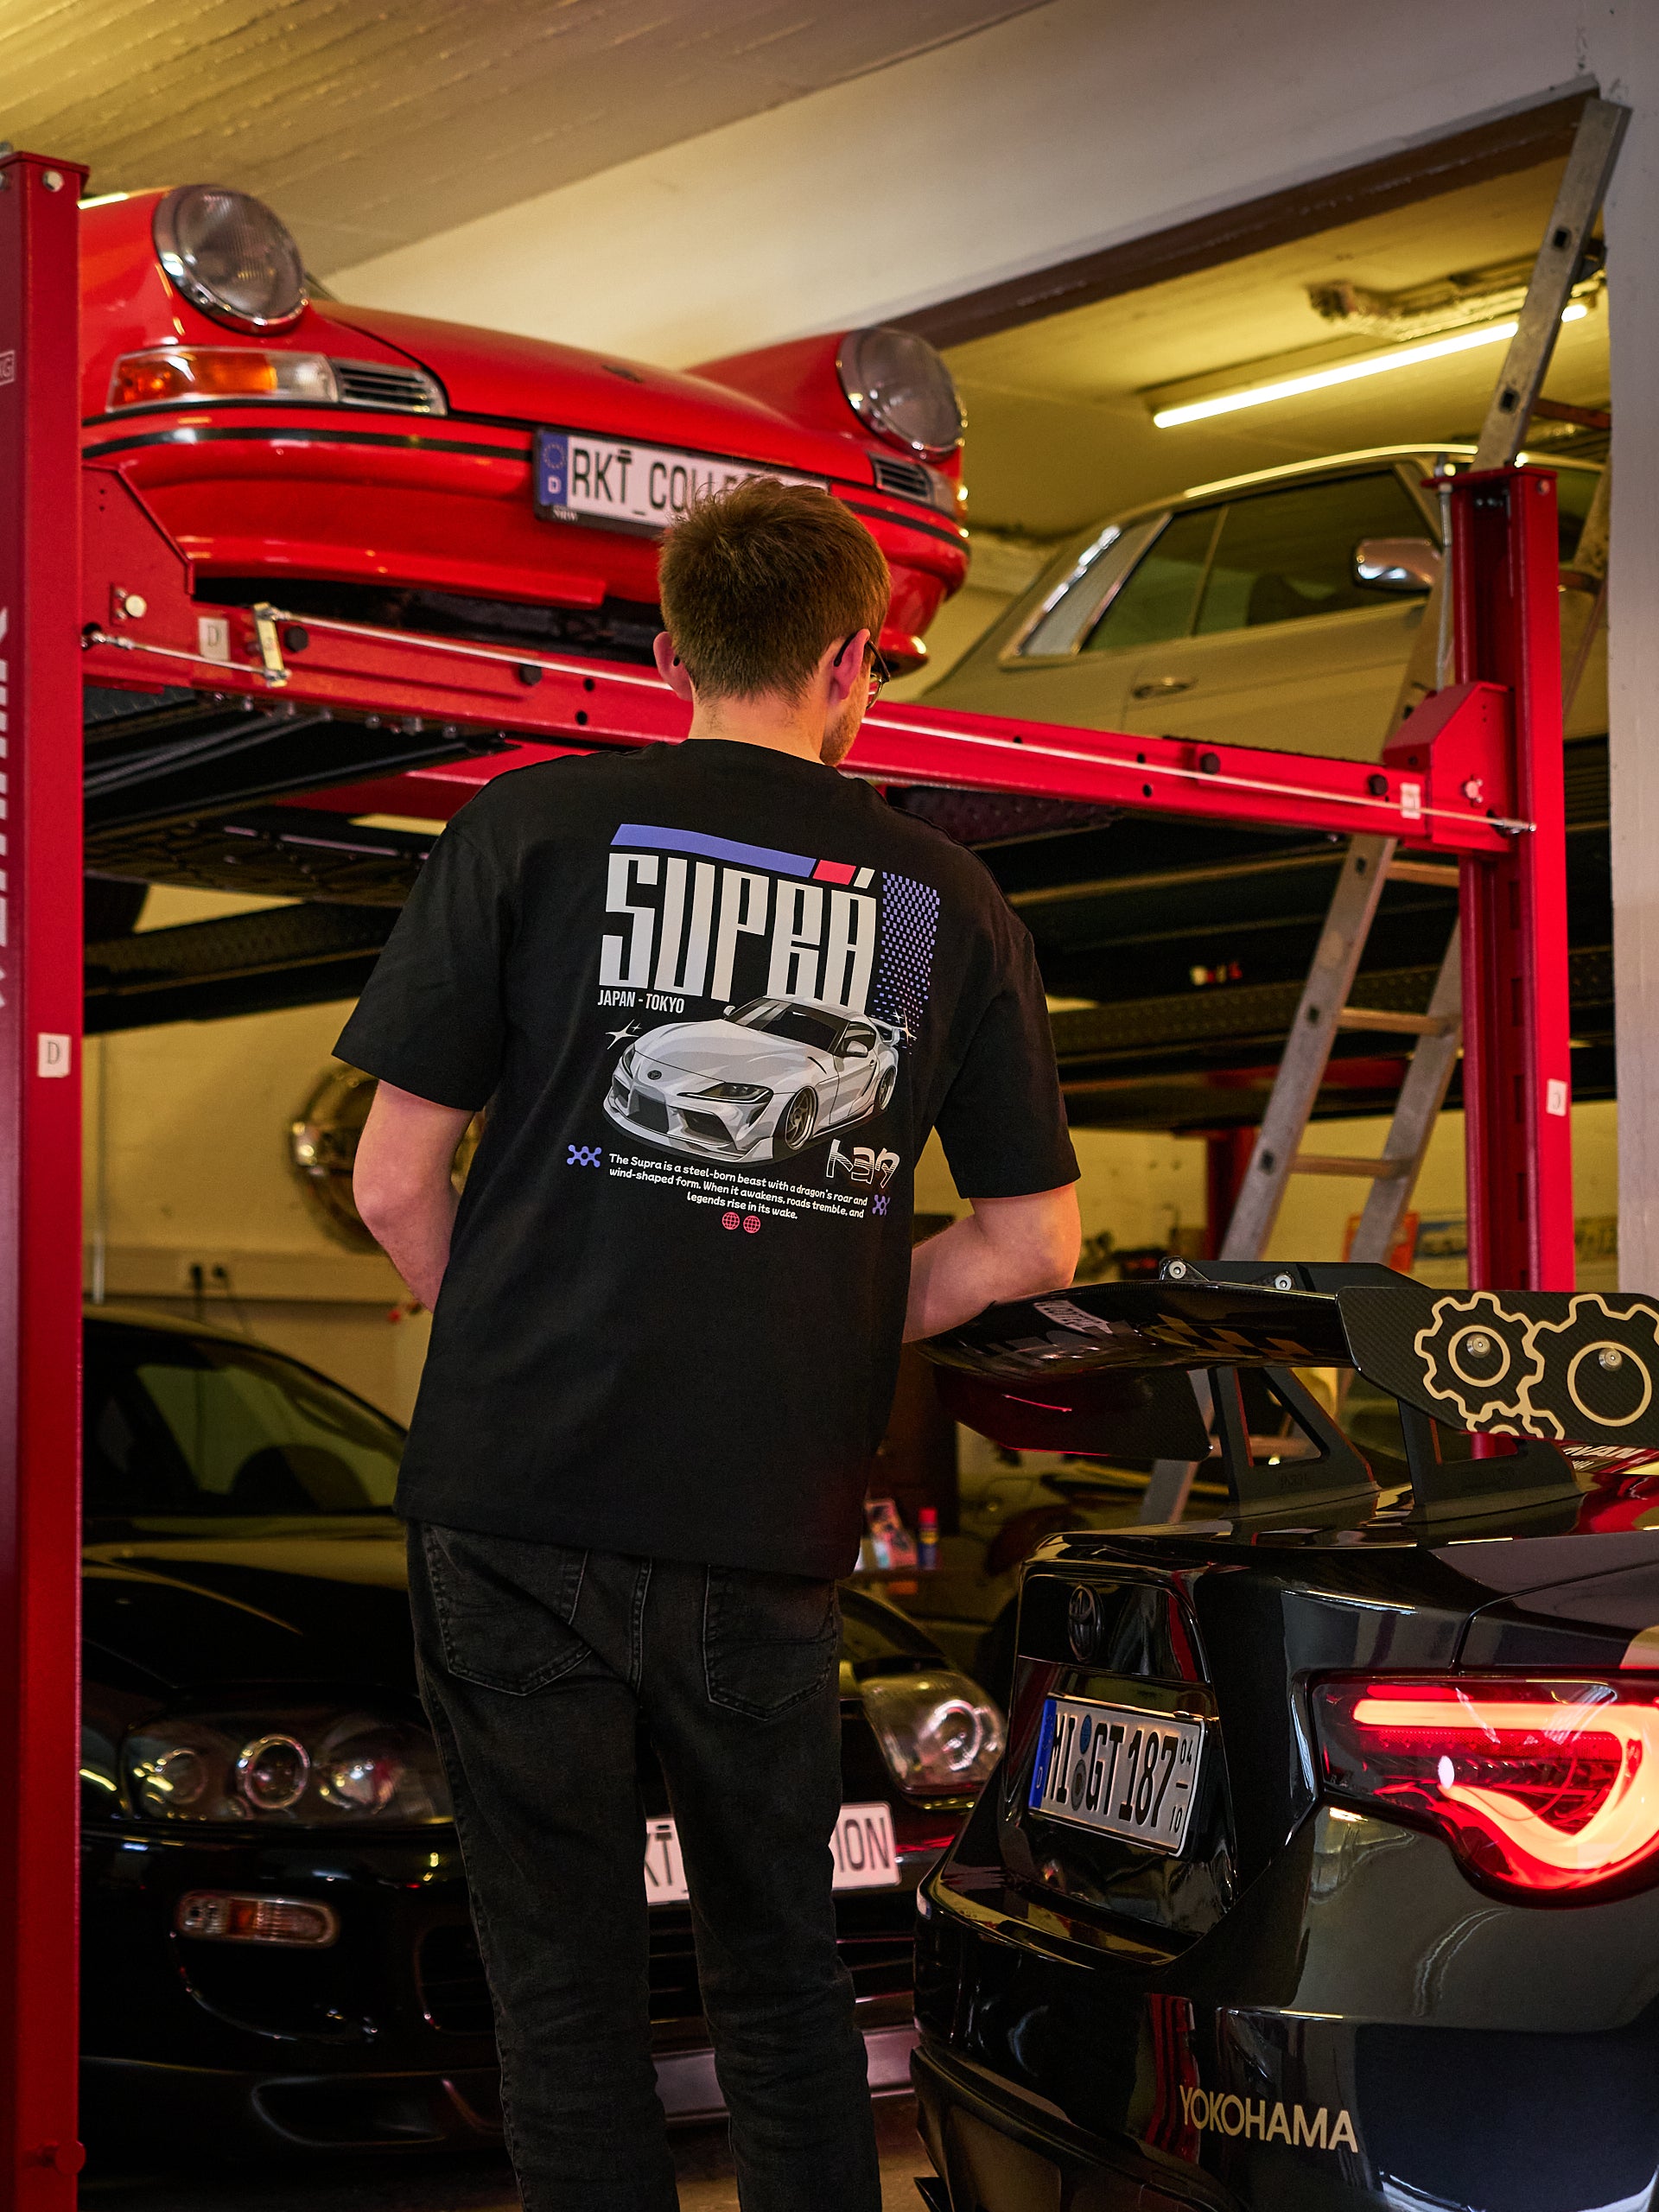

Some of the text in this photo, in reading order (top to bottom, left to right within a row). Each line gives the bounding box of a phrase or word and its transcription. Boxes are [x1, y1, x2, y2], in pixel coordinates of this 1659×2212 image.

[547, 475, 562, 494] D
[571, 447, 632, 505] RKT
[599, 853, 877, 1014] SUPRA
[597, 989, 636, 1007] JAPAN
[645, 994, 685, 1014] TOKYO
[46, 1040, 60, 1065] D
[608, 1153, 629, 1166] The
[630, 1156, 663, 1170] Supra
[663, 1160, 673, 1172] is
[674, 1164, 682, 1173] a
[683, 1166, 736, 1182] steel-born
[737, 1173, 767, 1187] beast
[767, 1179, 789, 1192] with
[796, 1184, 833, 1200] dragon's
[833, 1193, 854, 1204] roar
[853, 1197, 868, 1206] and
[826, 1138, 900, 1189] トヨタ
[609, 1167, 865, 1218] wind-shaped form. When it awakens, roads tremble, and
[686, 1191, 798, 1219] legends rise in its wake.
[1044, 1713, 1179, 1828] MI GT 187
[1179, 1738, 1193, 1767] 04
[1168, 1804, 1184, 1834] 10
[1179, 2084, 1359, 2153] YOKOHAMA
